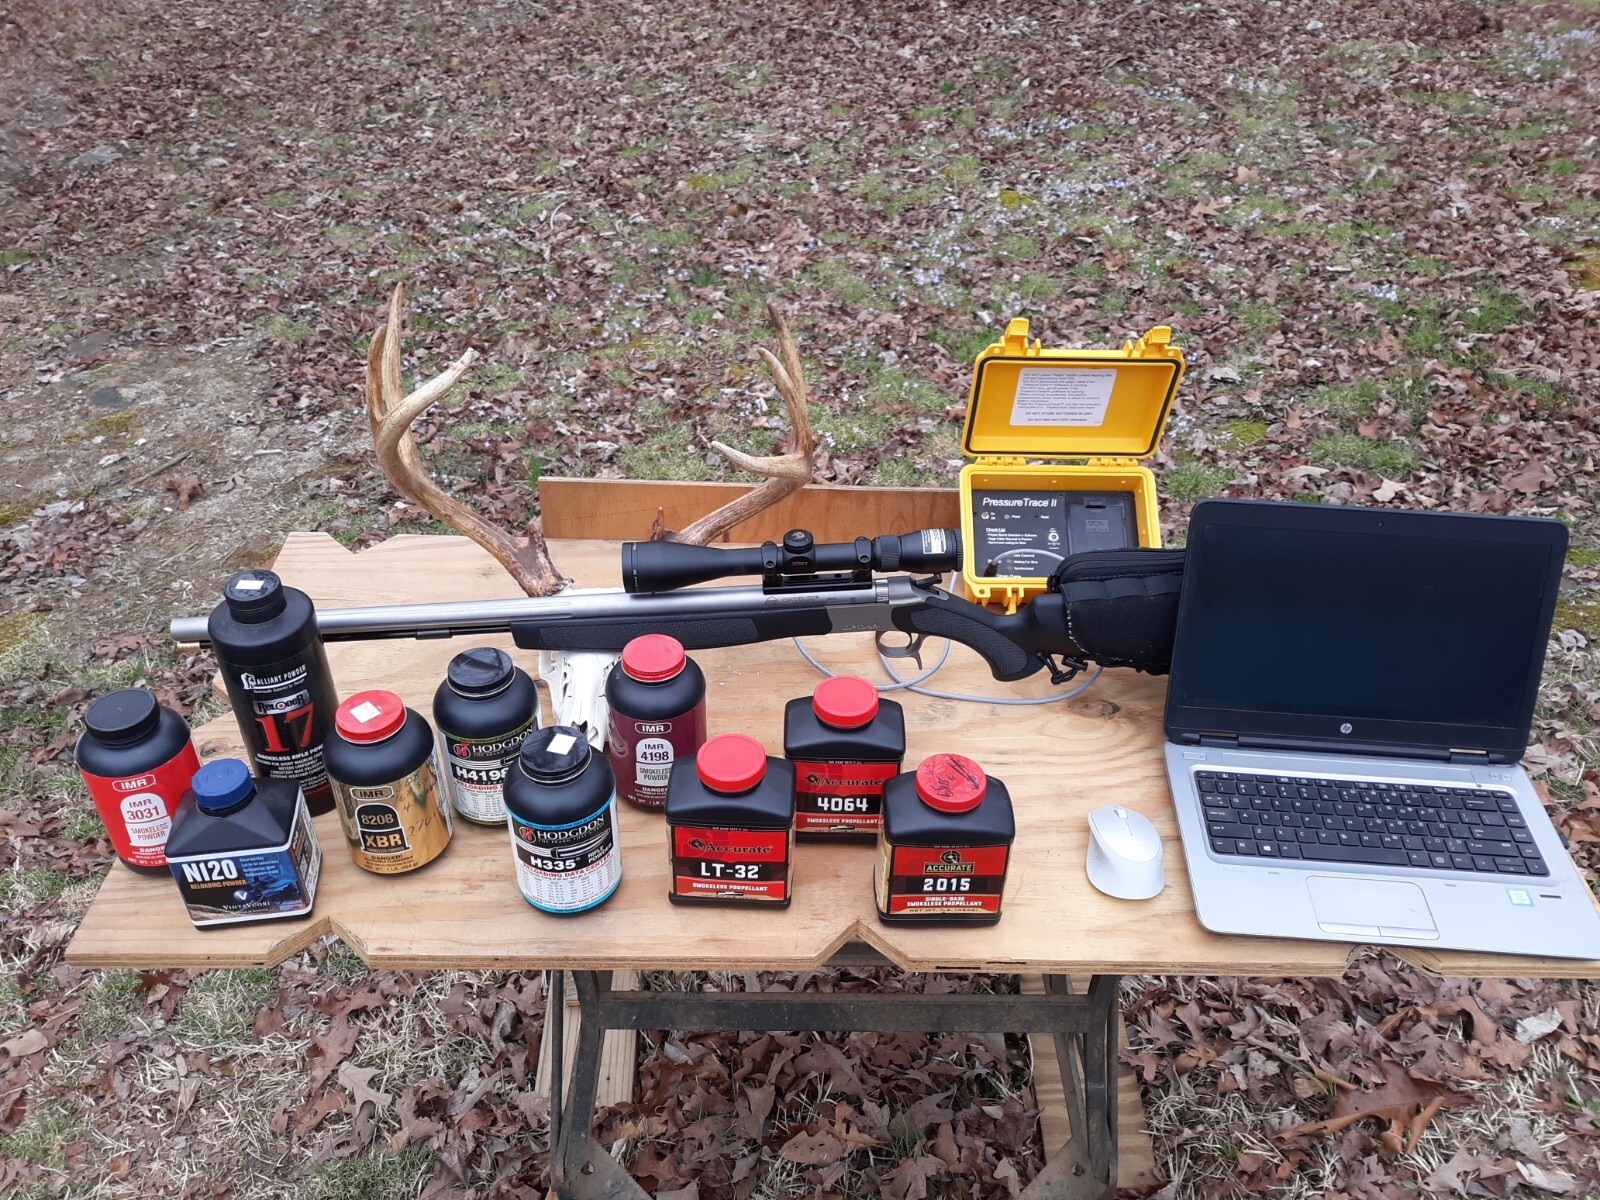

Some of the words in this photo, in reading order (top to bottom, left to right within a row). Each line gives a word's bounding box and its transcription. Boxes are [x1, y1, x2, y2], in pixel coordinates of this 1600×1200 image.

[982, 497, 1048, 507] PressureTrace
[257, 675, 282, 685] ALLIANT
[283, 664, 306, 680] POWDER
[255, 702, 314, 753] 17
[472, 725, 533, 753] HODGDON
[292, 751, 309, 759] RIFLE
[641, 751, 669, 761] 4198
[121, 778, 147, 790] IMR
[457, 780, 498, 791] RELOADING
[822, 778, 882, 786] Accurate
[359, 790, 384, 798] IMR
[129, 799, 152, 808] IMR
[818, 798, 868, 811] 4064
[126, 806, 160, 820] 3031
[361, 814, 394, 825] 8208
[131, 822, 168, 834] SMOKELESS
[538, 814, 604, 839] HODGDON
[138, 830, 166, 840] POWDER
[365, 835, 402, 848] XBR
[588, 846, 603, 858] RIFLE
[588, 843, 612, 863] POWDER
[705, 843, 771, 853] Accurate
[523, 863, 562, 878] RELOADING
[586, 853, 611, 871] CENTER
[530, 856, 576, 870] H335
[926, 864, 972, 872] ACCURATE
[701, 862, 758, 879] LT-32
[222, 879, 247, 887] POWDER
[923, 878, 971, 891] 2015
